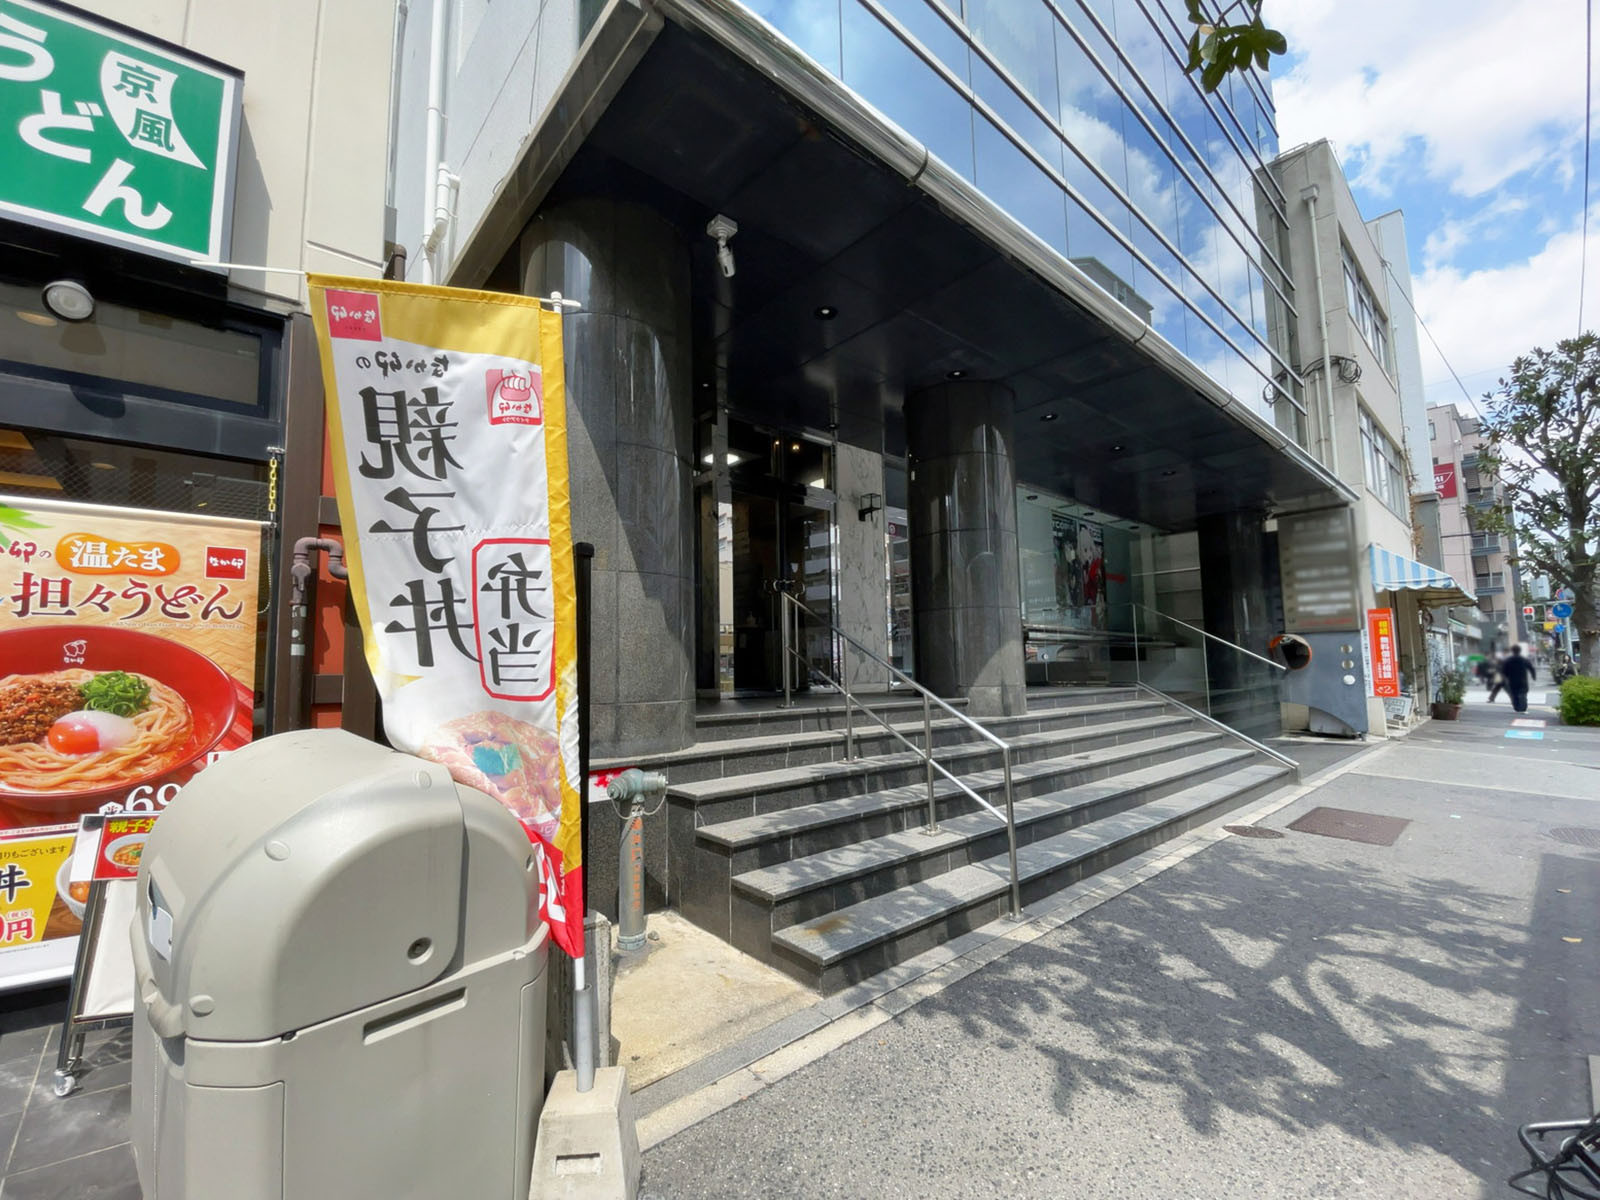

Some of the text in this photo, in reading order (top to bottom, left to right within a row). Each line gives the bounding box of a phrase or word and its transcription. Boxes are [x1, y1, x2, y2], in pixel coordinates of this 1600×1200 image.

[111, 60, 176, 153] 京風
[0, 540, 52, 563] 卵の
[71, 538, 166, 573] 温たま
[209, 555, 245, 570] なか卵
[11, 571, 244, 621] 担々うどん
[0, 844, 67, 860] りもございます
[0, 916, 33, 941] 円
